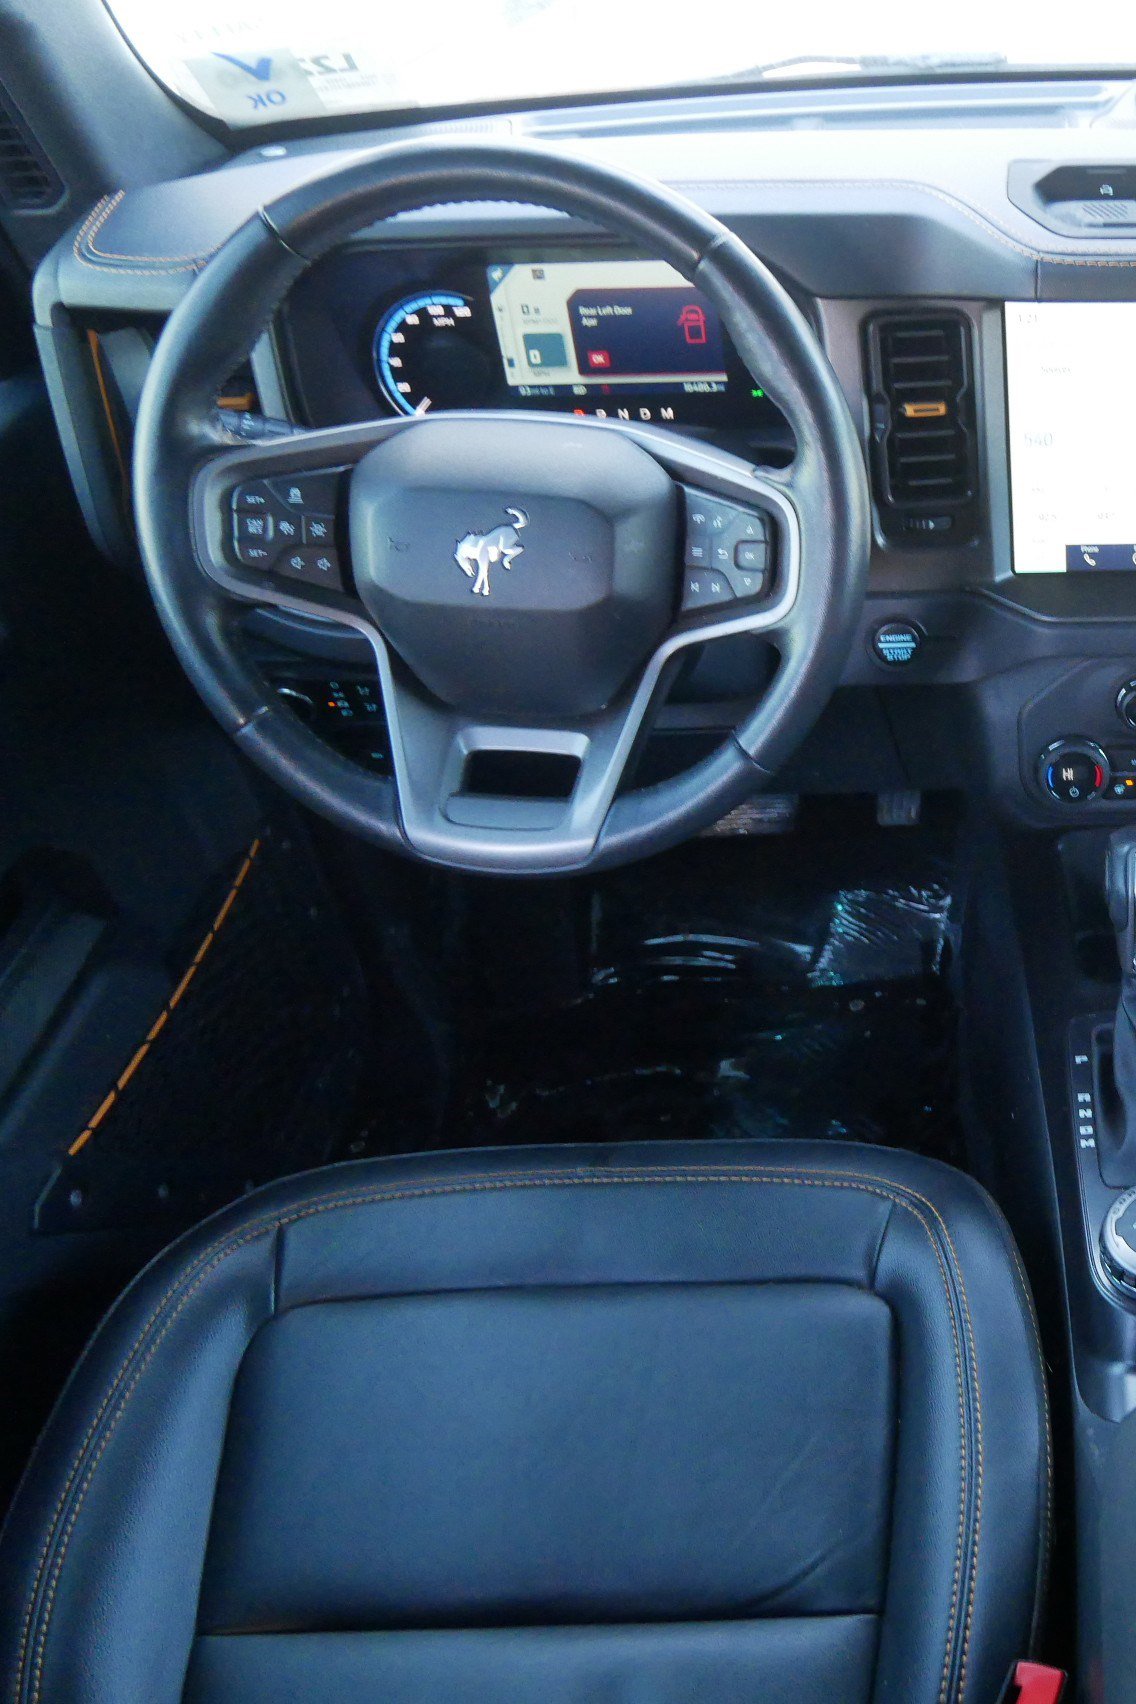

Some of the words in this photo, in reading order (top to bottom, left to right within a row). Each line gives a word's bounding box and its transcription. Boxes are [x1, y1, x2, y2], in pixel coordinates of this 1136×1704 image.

[578, 305, 597, 316] Rear
[597, 305, 614, 316] Left
[613, 305, 633, 316] Door
[433, 318, 454, 326] MPH
[592, 353, 606, 365] OK
[617, 408, 629, 420] N
[639, 407, 652, 420] D
[660, 406, 674, 420] M
[1080, 544, 1099, 553] Phone
[880, 633, 913, 642] ENGINE
[1078, 1108, 1093, 1119] N
[1080, 1138, 1096, 1149] M
